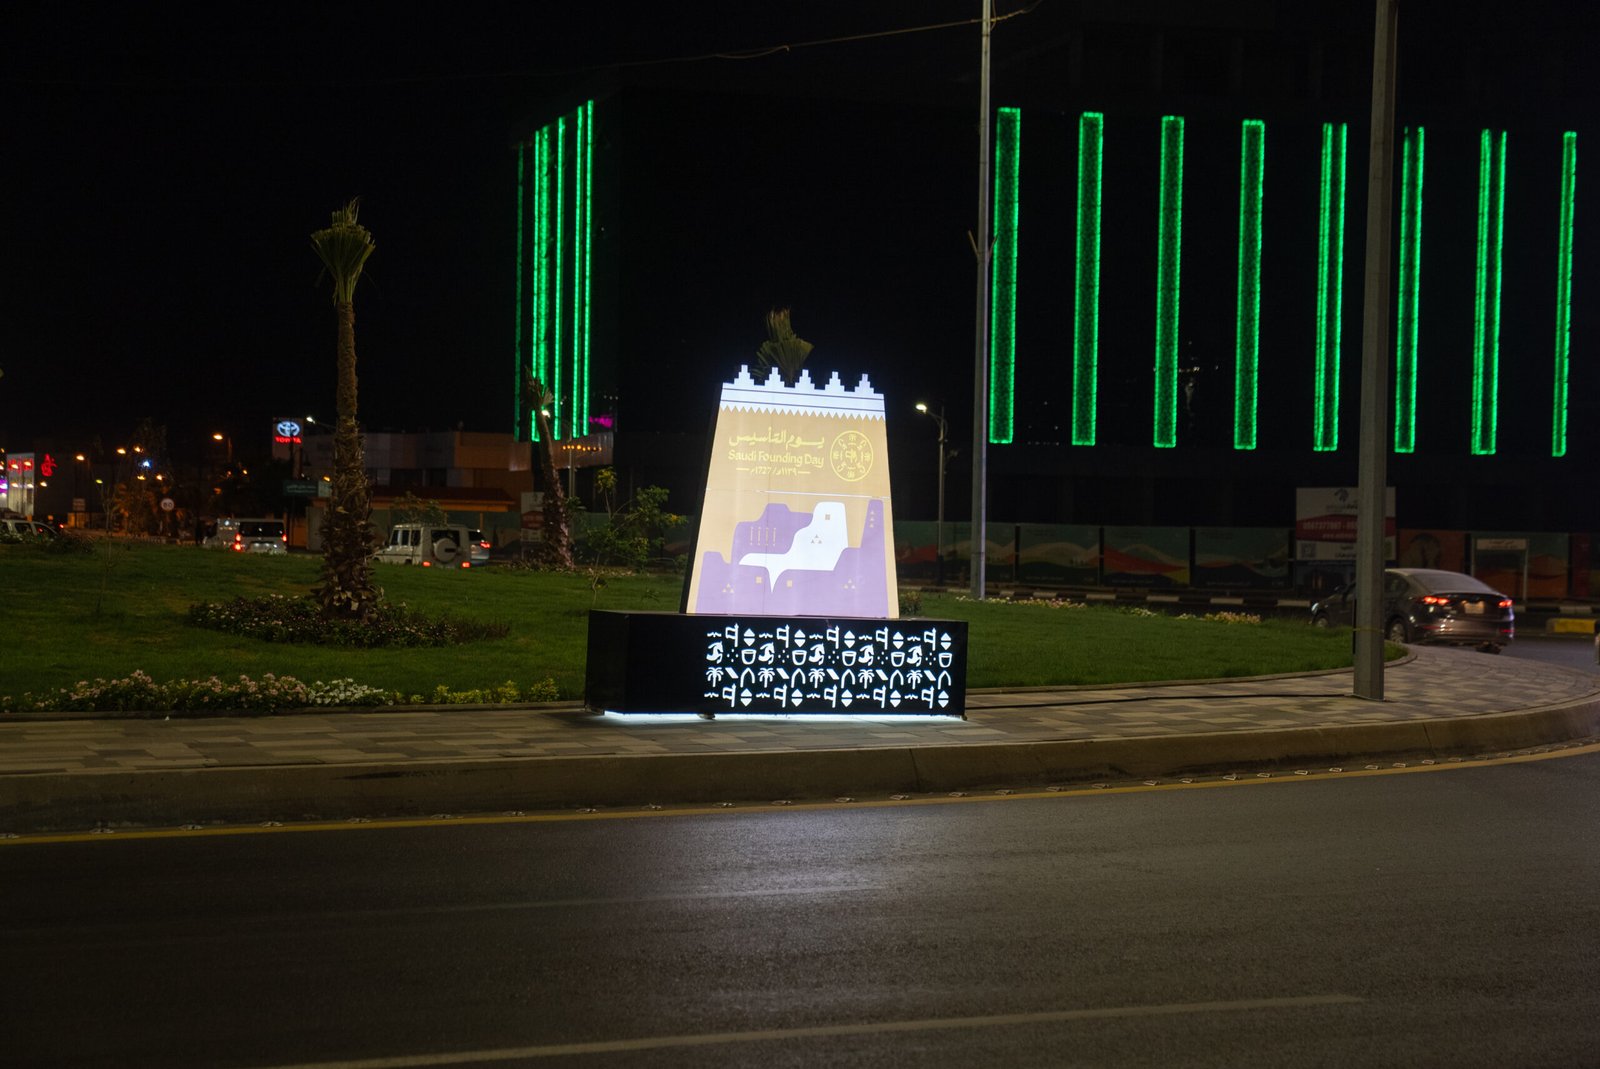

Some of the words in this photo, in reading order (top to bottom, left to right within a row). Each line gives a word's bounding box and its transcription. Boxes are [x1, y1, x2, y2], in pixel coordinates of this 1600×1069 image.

[728, 426, 787, 446] التأسيس
[785, 434, 825, 450] يوم
[728, 449, 757, 461] Saudi
[758, 450, 803, 467] Founding
[804, 453, 825, 468] Day
